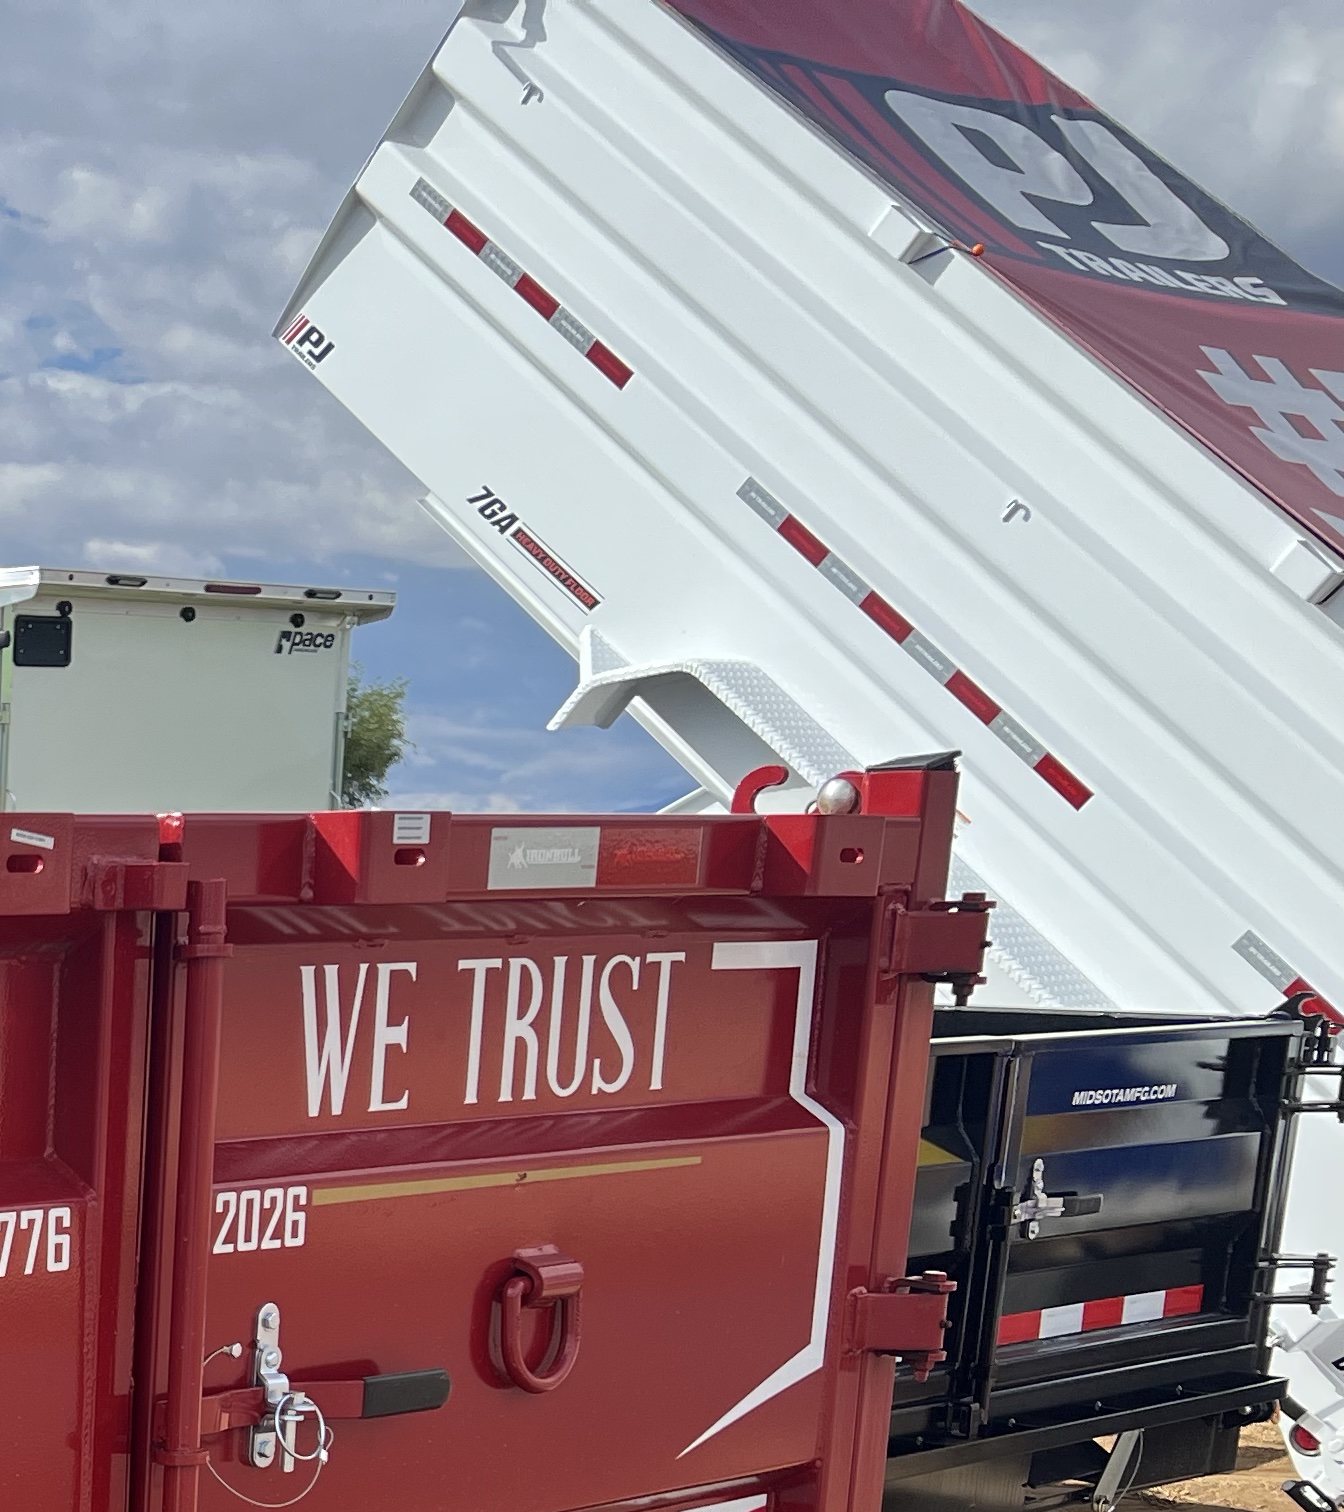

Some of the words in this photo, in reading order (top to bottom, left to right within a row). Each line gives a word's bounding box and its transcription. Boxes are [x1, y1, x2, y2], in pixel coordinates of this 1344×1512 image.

[884, 89, 1230, 261] PJ
[1036, 241, 1288, 305] TRAILERS
[296, 325, 335, 363] PJ
[466, 485, 520, 535] 7GA
[515, 531, 548, 560] HEAVY
[565, 578, 596, 608] FLOOR
[526, 848, 582, 864] IRONBULL
[300, 962, 418, 1117] WE
[457, 952, 687, 1104] TRUST
[1072, 1084, 1177, 1105] MIDSOTAMFG.COM
[213, 1185, 307, 1255] 2026
